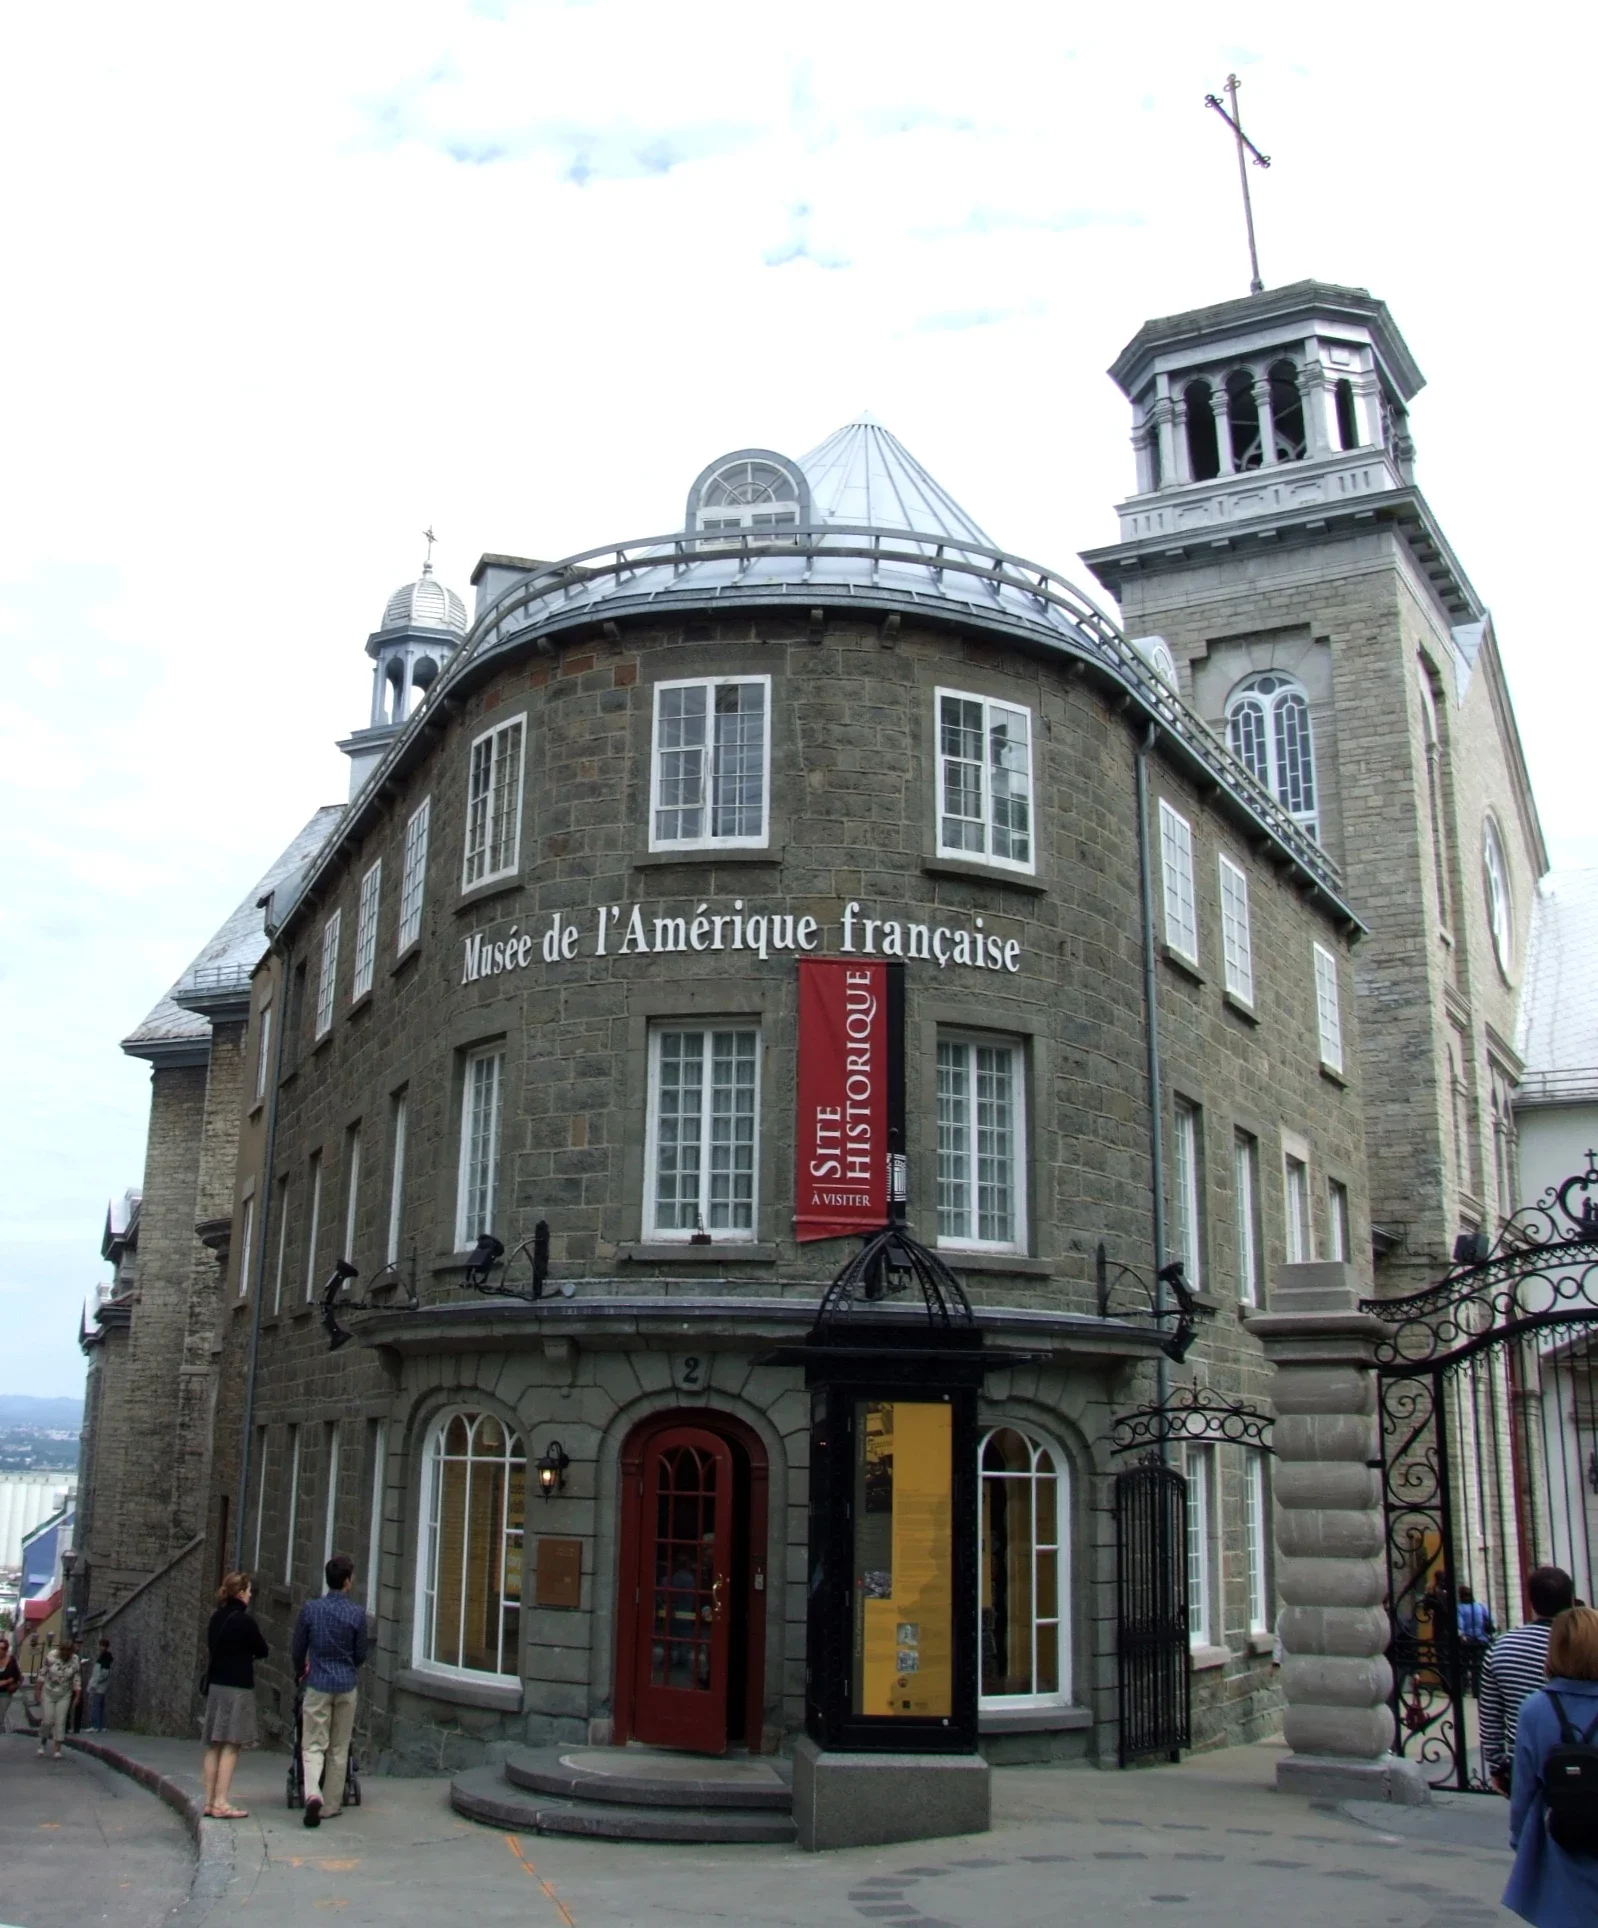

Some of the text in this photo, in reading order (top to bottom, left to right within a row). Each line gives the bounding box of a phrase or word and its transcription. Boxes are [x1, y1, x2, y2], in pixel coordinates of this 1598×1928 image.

[461, 900, 1020, 985] Musée de l'Amérique française
[846, 970, 877, 1179] HISTORIQUE
[810, 1105, 841, 1178] SITE
[812, 1190, 871, 1207] À VISITER
[683, 1356, 699, 1384] 2
